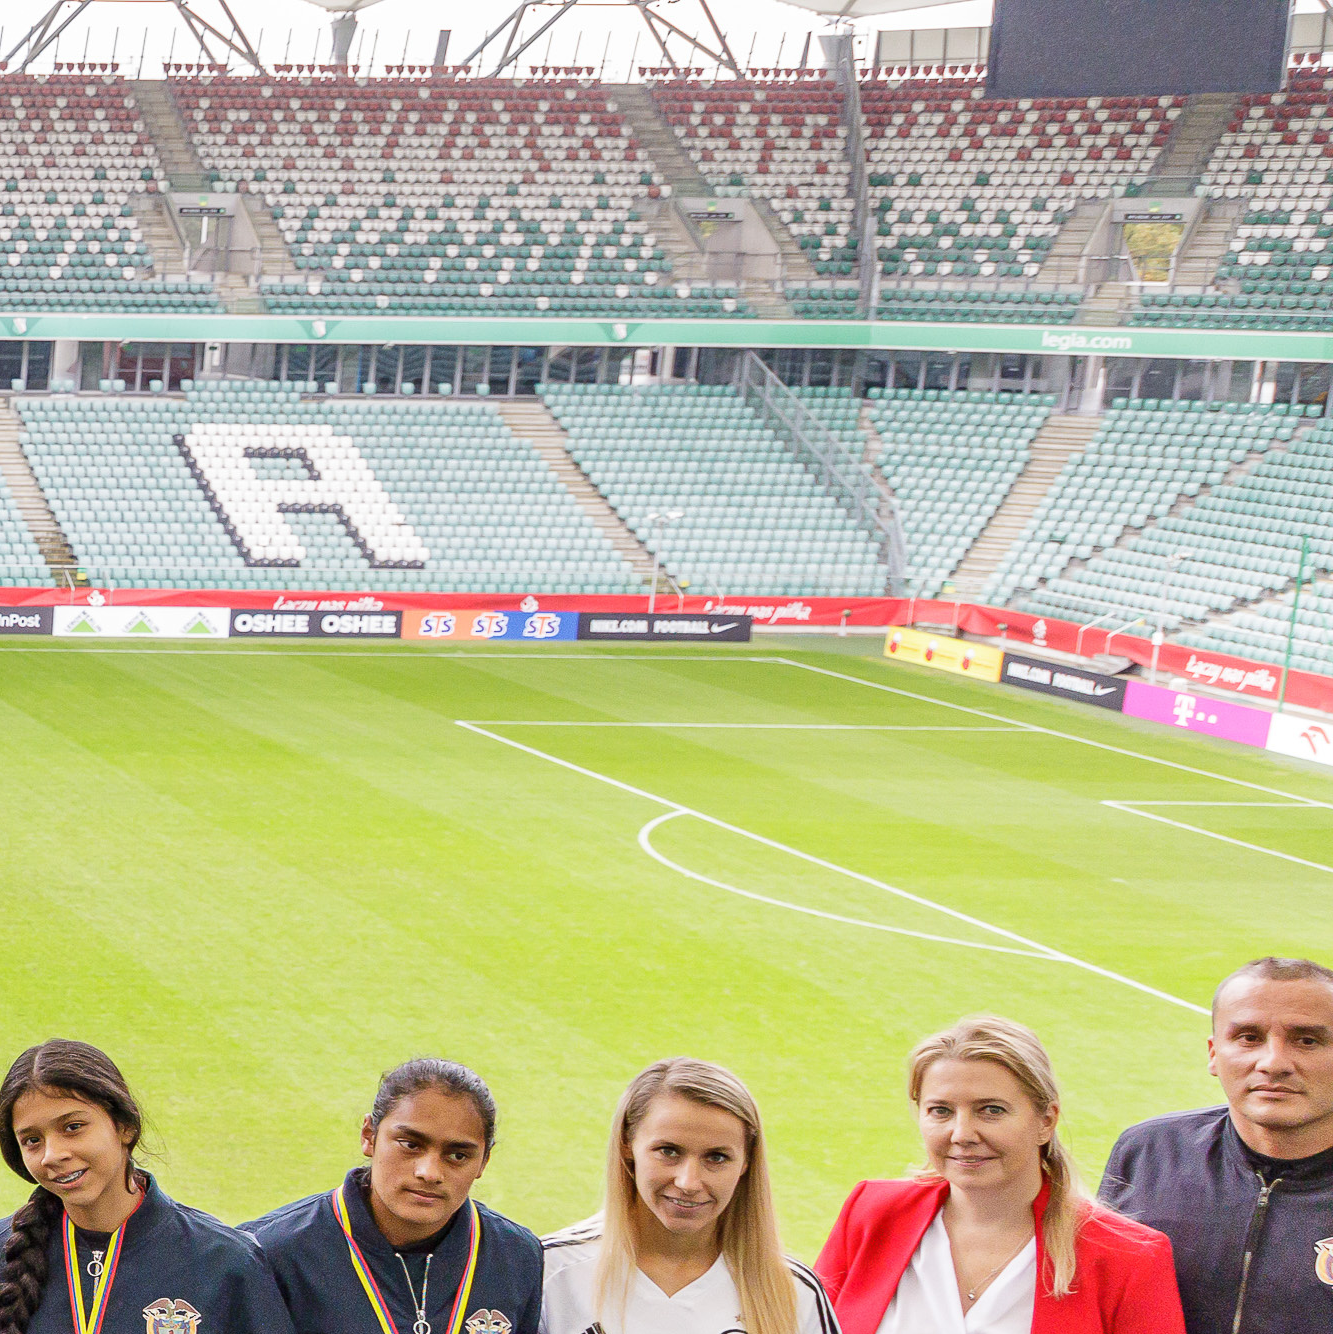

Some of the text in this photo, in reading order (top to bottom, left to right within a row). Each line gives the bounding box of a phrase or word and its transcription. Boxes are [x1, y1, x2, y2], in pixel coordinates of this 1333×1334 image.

[1042, 331, 1132, 351] legia.com
[234, 613, 310, 633] OSHEE
[320, 614, 397, 634] OSHEE
[420, 612, 455, 636] STS
[472, 613, 508, 637] STS
[524, 613, 559, 638] STS
